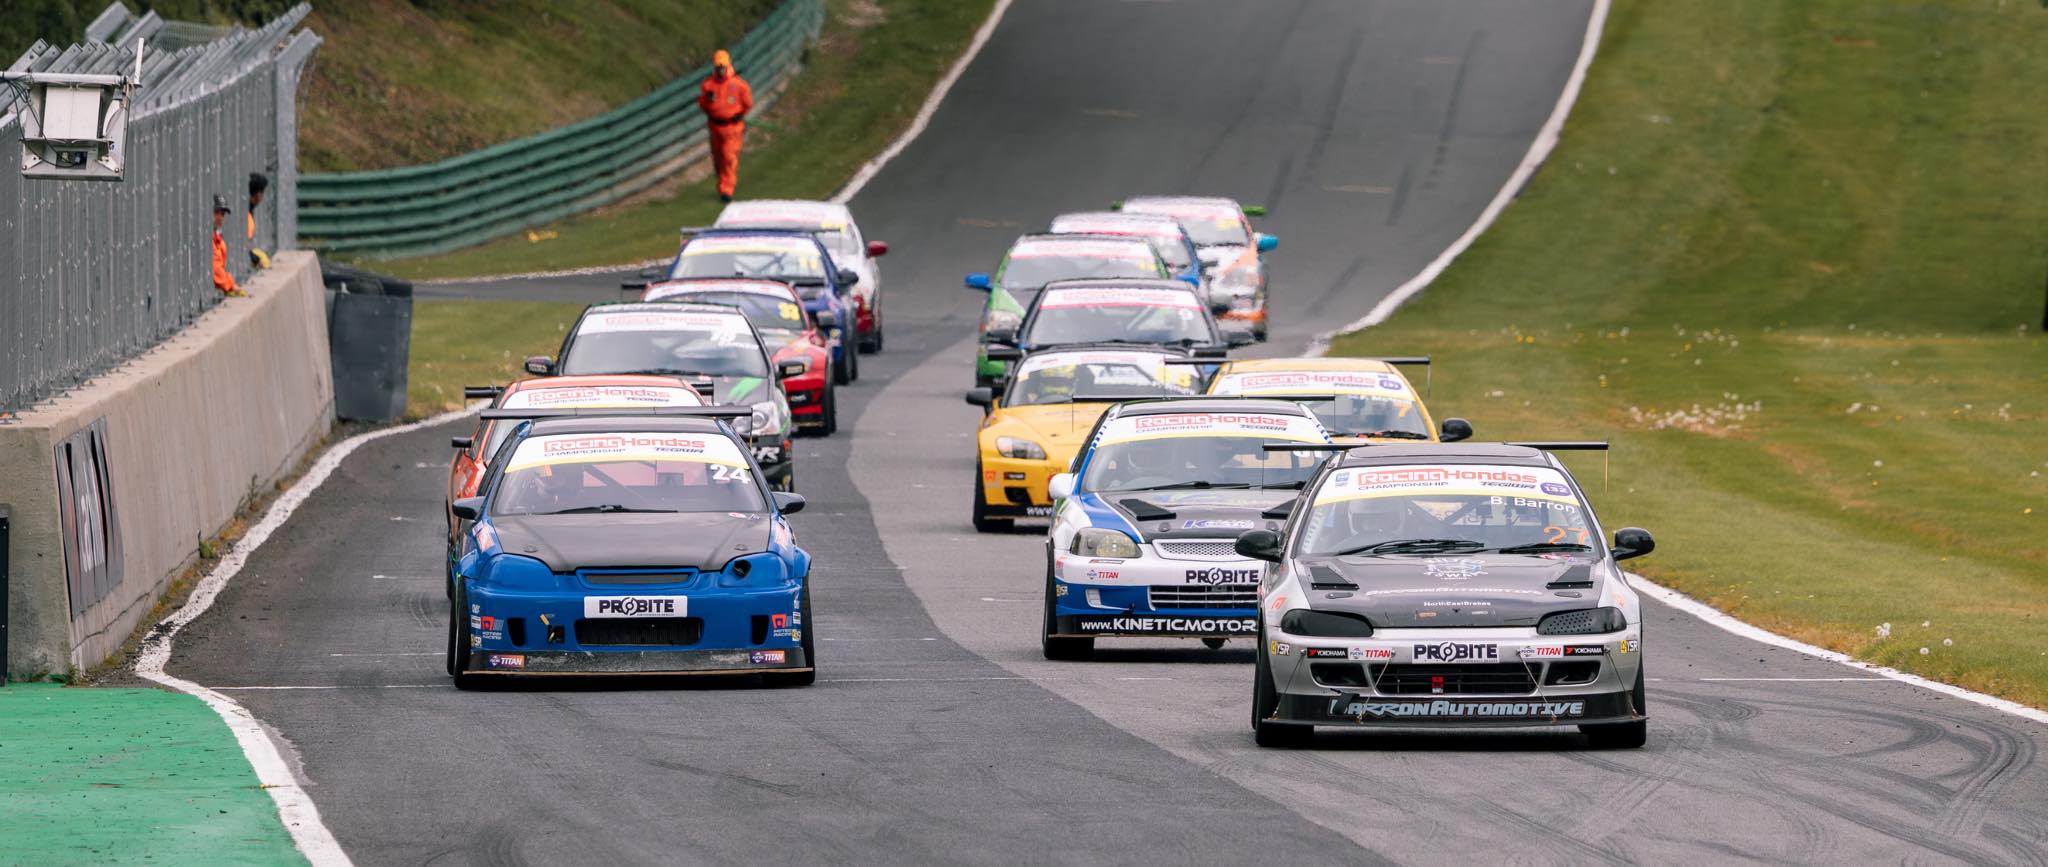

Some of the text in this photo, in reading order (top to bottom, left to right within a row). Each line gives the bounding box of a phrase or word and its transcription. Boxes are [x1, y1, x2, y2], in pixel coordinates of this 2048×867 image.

[710, 463, 750, 484] 24
[1358, 481, 1450, 491] CHAMPIONSHIP
[1490, 496, 1576, 514] B. Barron
[1543, 526, 1589, 546] 27
[1098, 571, 1120, 579] TITAN
[1081, 618, 1258, 632] www.KINETICMOTOR
[1317, 649, 1347, 657] YOKOHAMA
[1365, 649, 1391, 658] TITAN
[1536, 647, 1562, 656] TITAN
[501, 657, 523, 666] TITAN
[764, 653, 784, 662] TITAN
